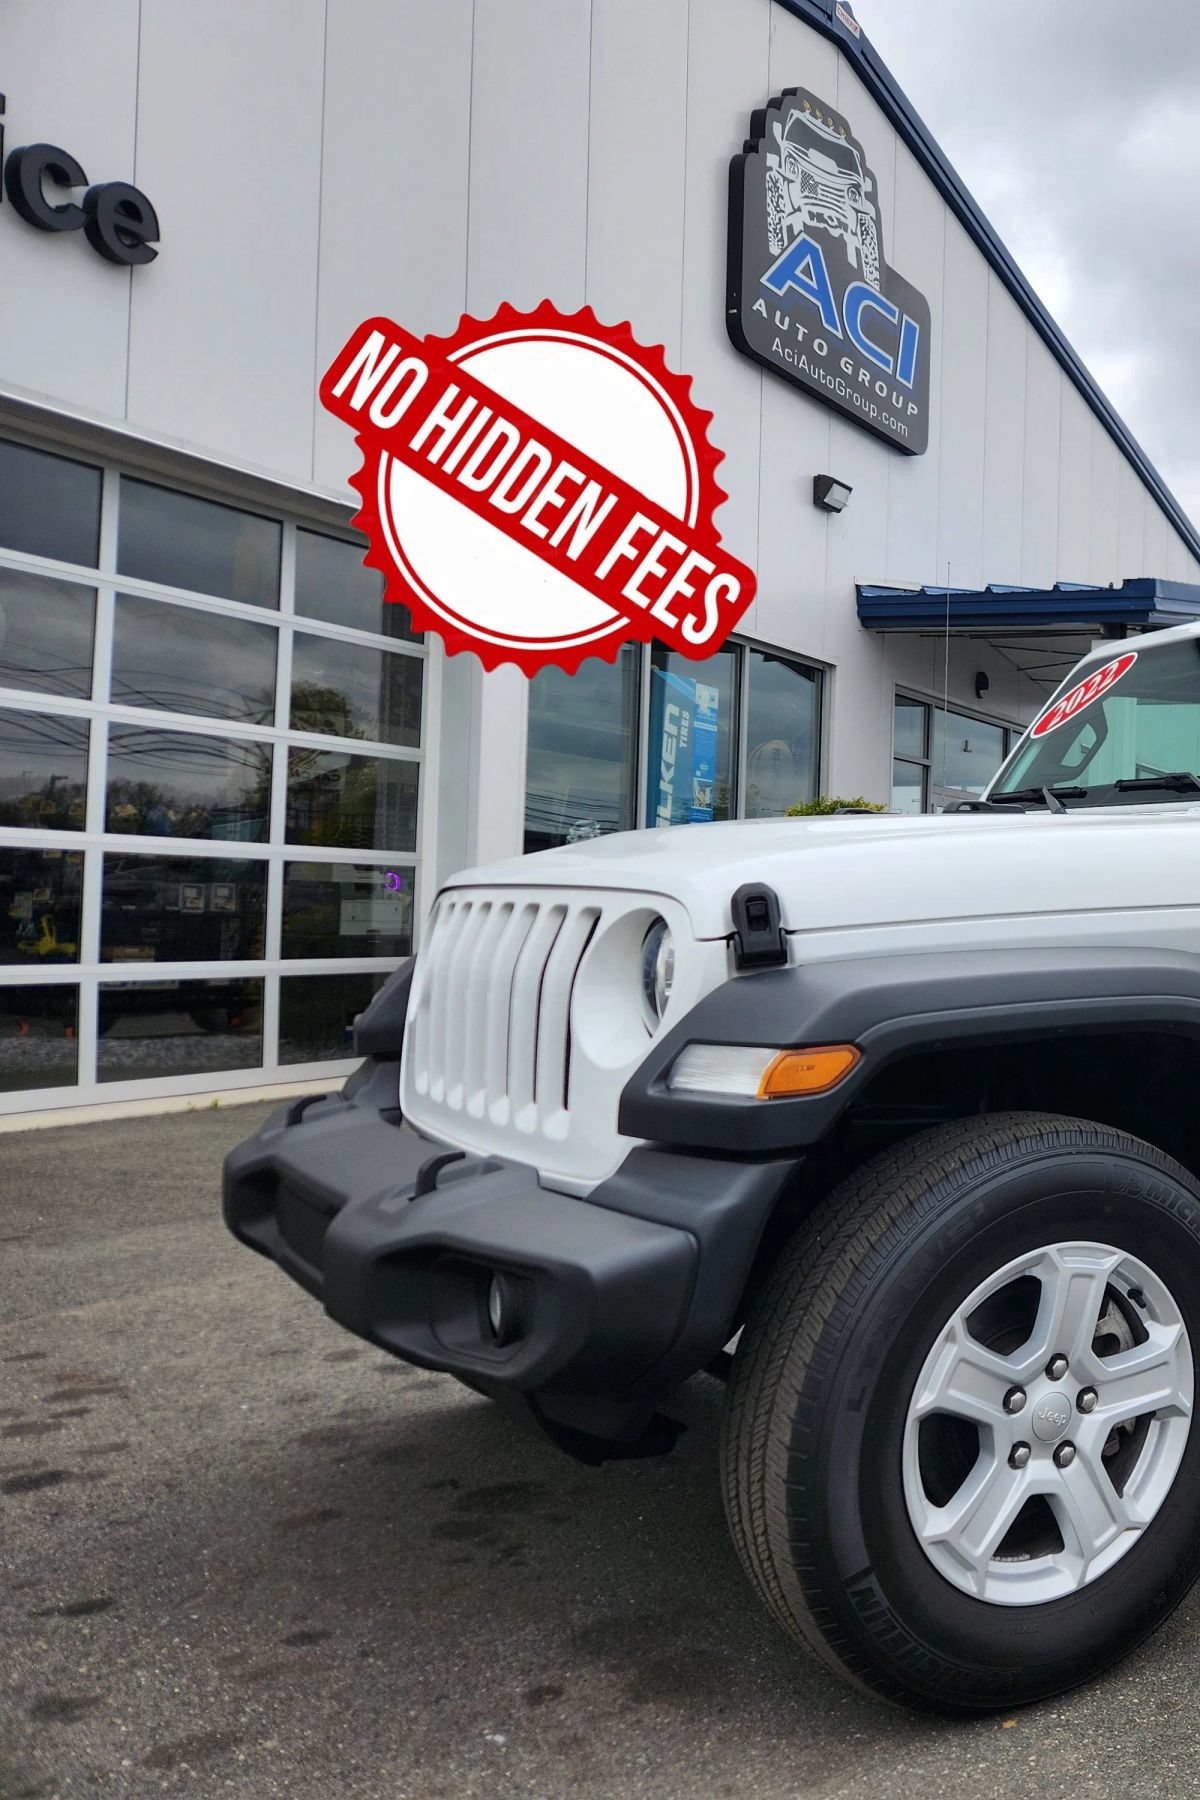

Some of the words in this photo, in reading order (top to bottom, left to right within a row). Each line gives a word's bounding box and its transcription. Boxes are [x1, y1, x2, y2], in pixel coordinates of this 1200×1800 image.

[0, 90, 160, 266] ce
[752, 297, 828, 357] AUTO
[840, 358, 919, 418] GROUP
[760, 230, 920, 390] ACI
[771, 336, 909, 438] AciAutoGroup.com
[679, 710, 690, 749] TIRES
[1045, 661, 1120, 730] 2022
[1038, 1407, 1067, 1427] Jeep
